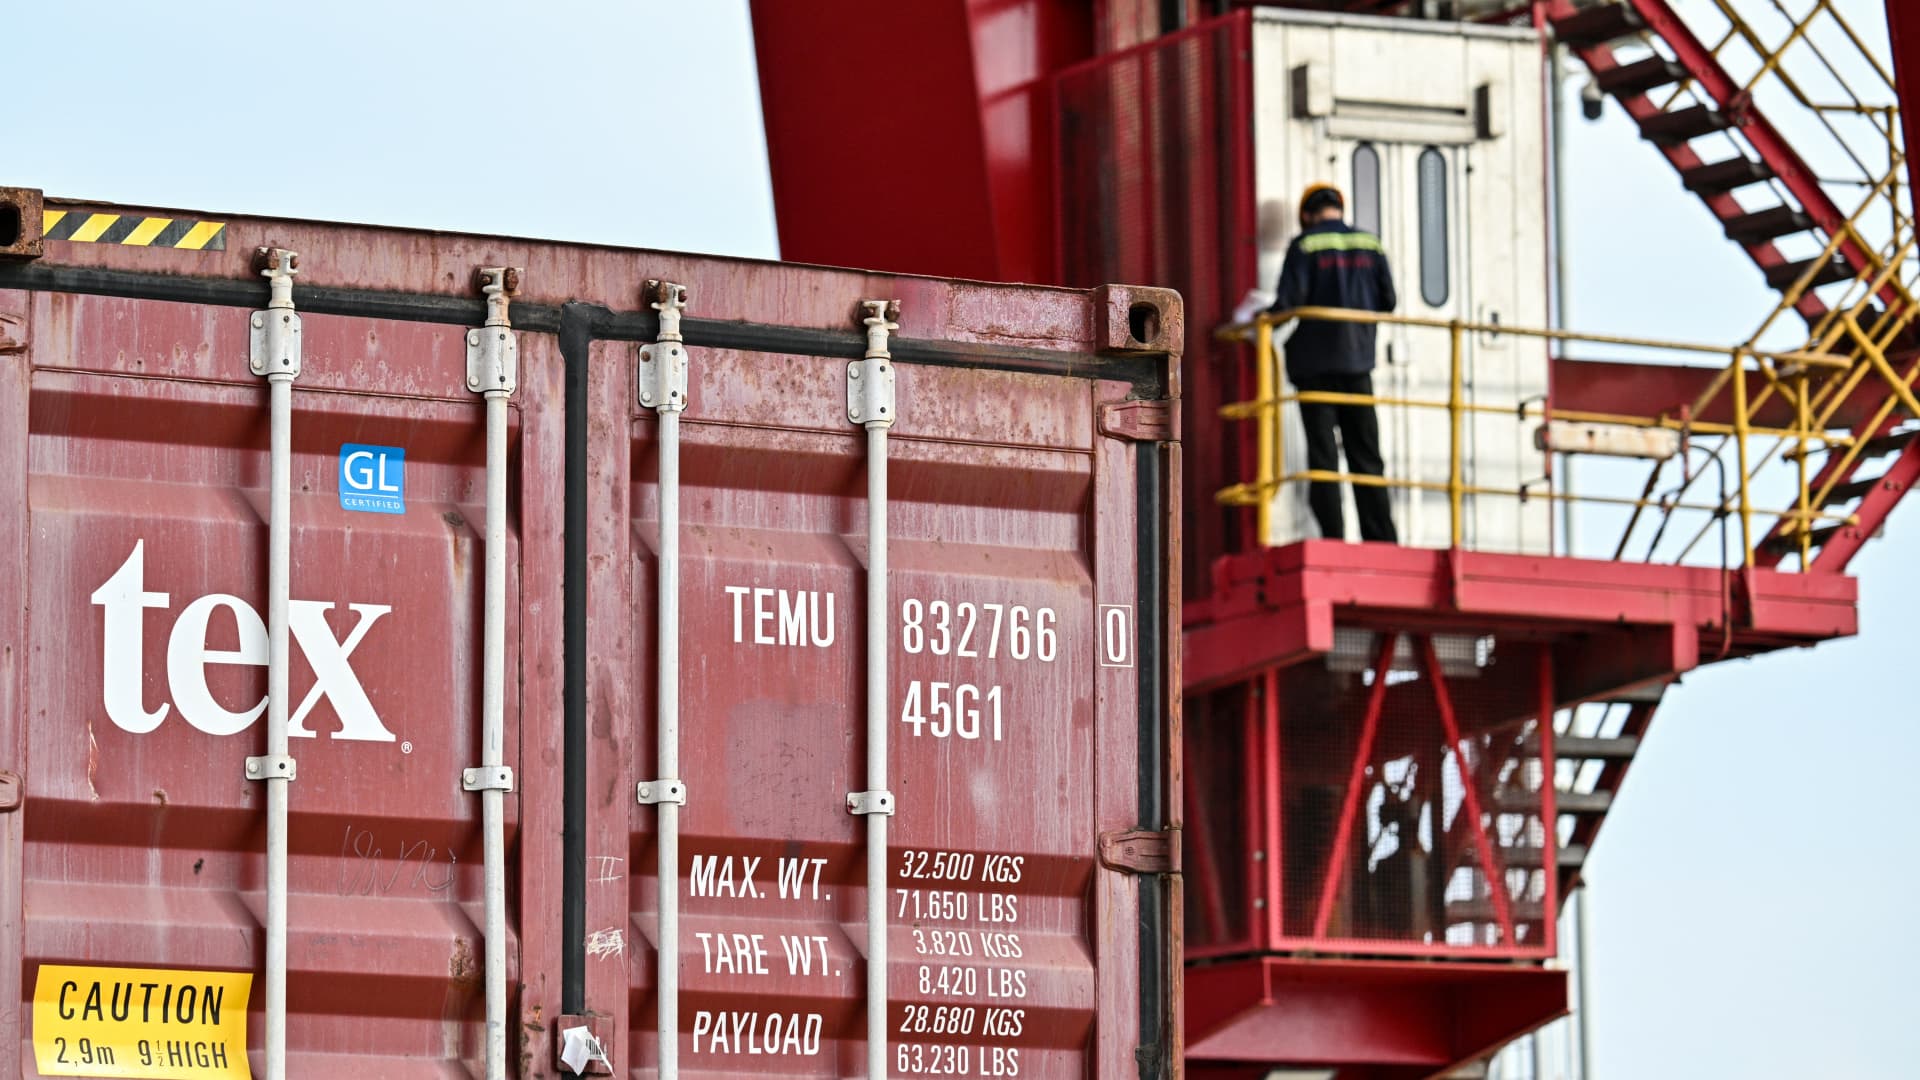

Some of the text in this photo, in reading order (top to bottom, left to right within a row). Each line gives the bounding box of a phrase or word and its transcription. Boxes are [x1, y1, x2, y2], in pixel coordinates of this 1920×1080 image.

[344, 450, 399, 492] GL
[344, 497, 401, 510] CERTIFIED
[91, 539, 396, 742] tex
[725, 586, 1126, 662] TEMU 832766 0
[902, 681, 1002, 741] 45G1
[690, 854, 831, 900] MAX. WT.
[981, 855, 1024, 883] KGS
[979, 893, 1018, 923] LBS
[696, 933, 841, 977] TARE WT.
[980, 932, 1023, 959] KGS
[58, 980, 224, 1026] CAUTION
[987, 968, 1027, 998] LBS
[693, 1011, 823, 1056] PAYLOAD
[982, 1008, 1025, 1037] KGS
[979, 1046, 1019, 1077] LBS
